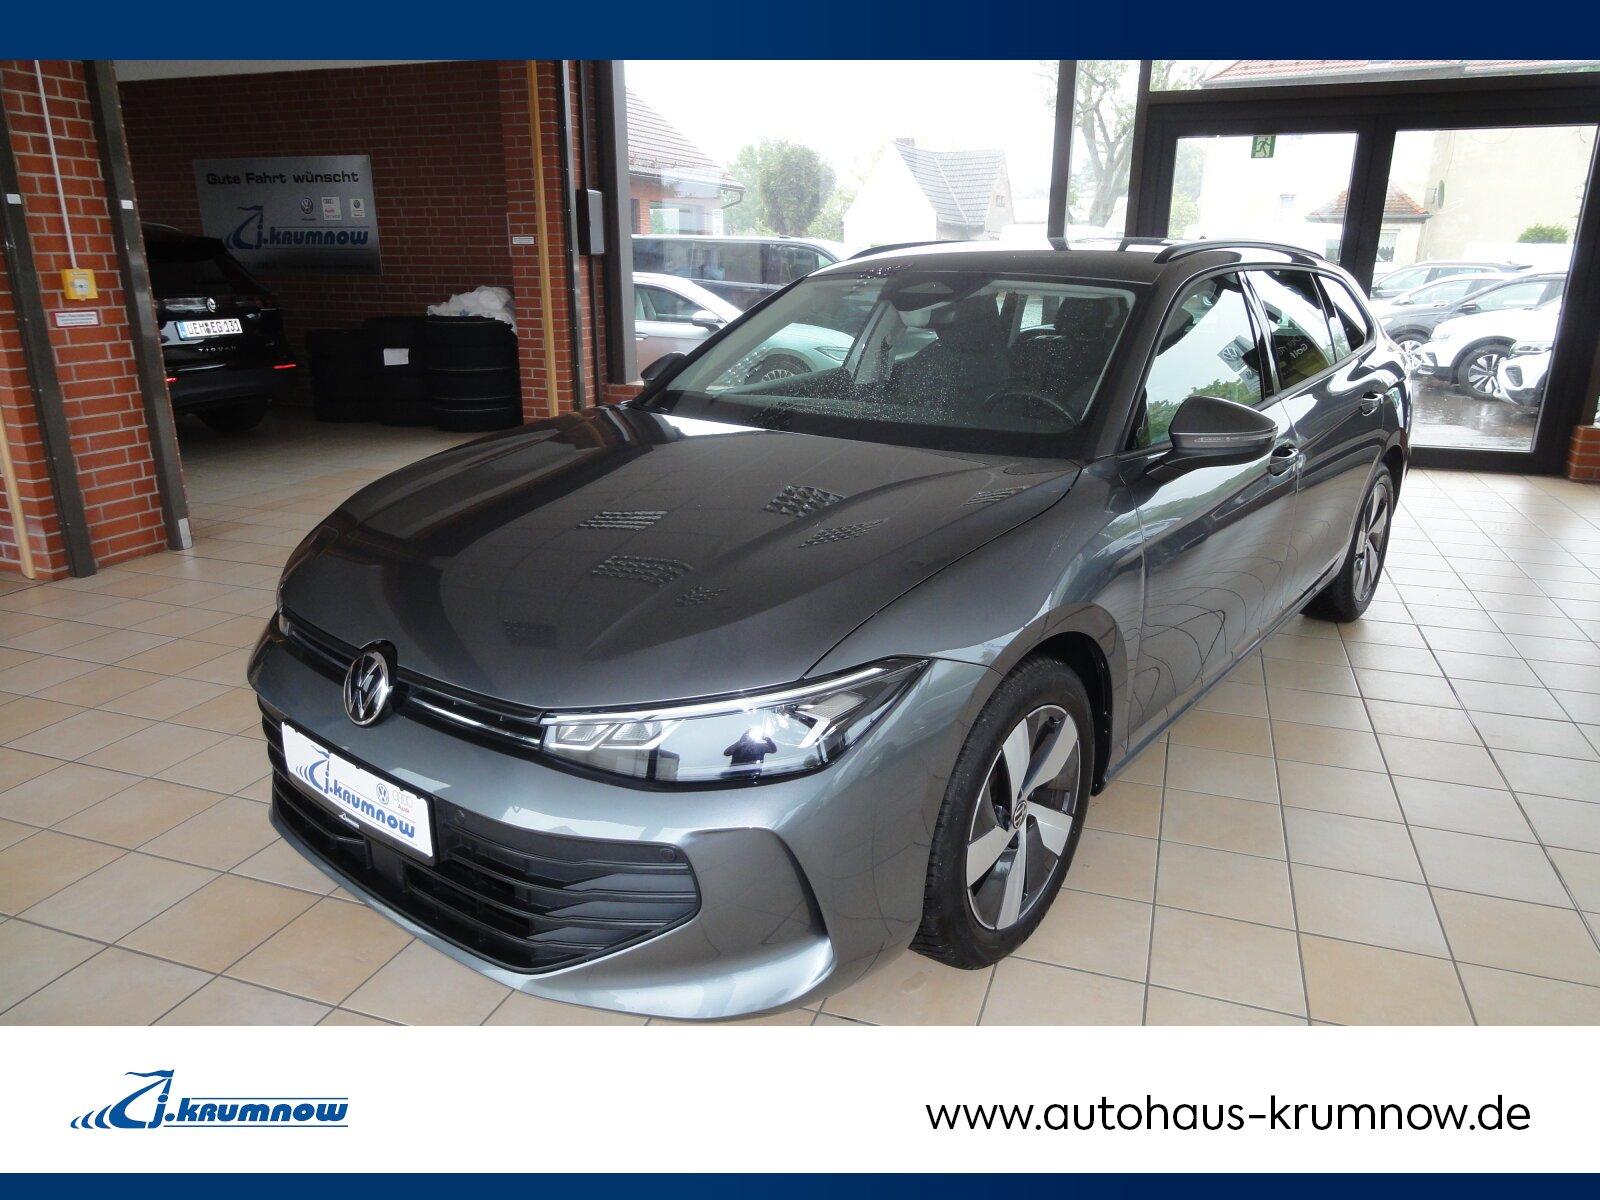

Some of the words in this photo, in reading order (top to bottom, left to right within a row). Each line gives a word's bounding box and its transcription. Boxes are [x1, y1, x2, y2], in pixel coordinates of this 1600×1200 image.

[206, 172, 241, 185] Gute
[246, 172, 286, 184] Fahrt
[292, 170, 359, 184] wünscht
